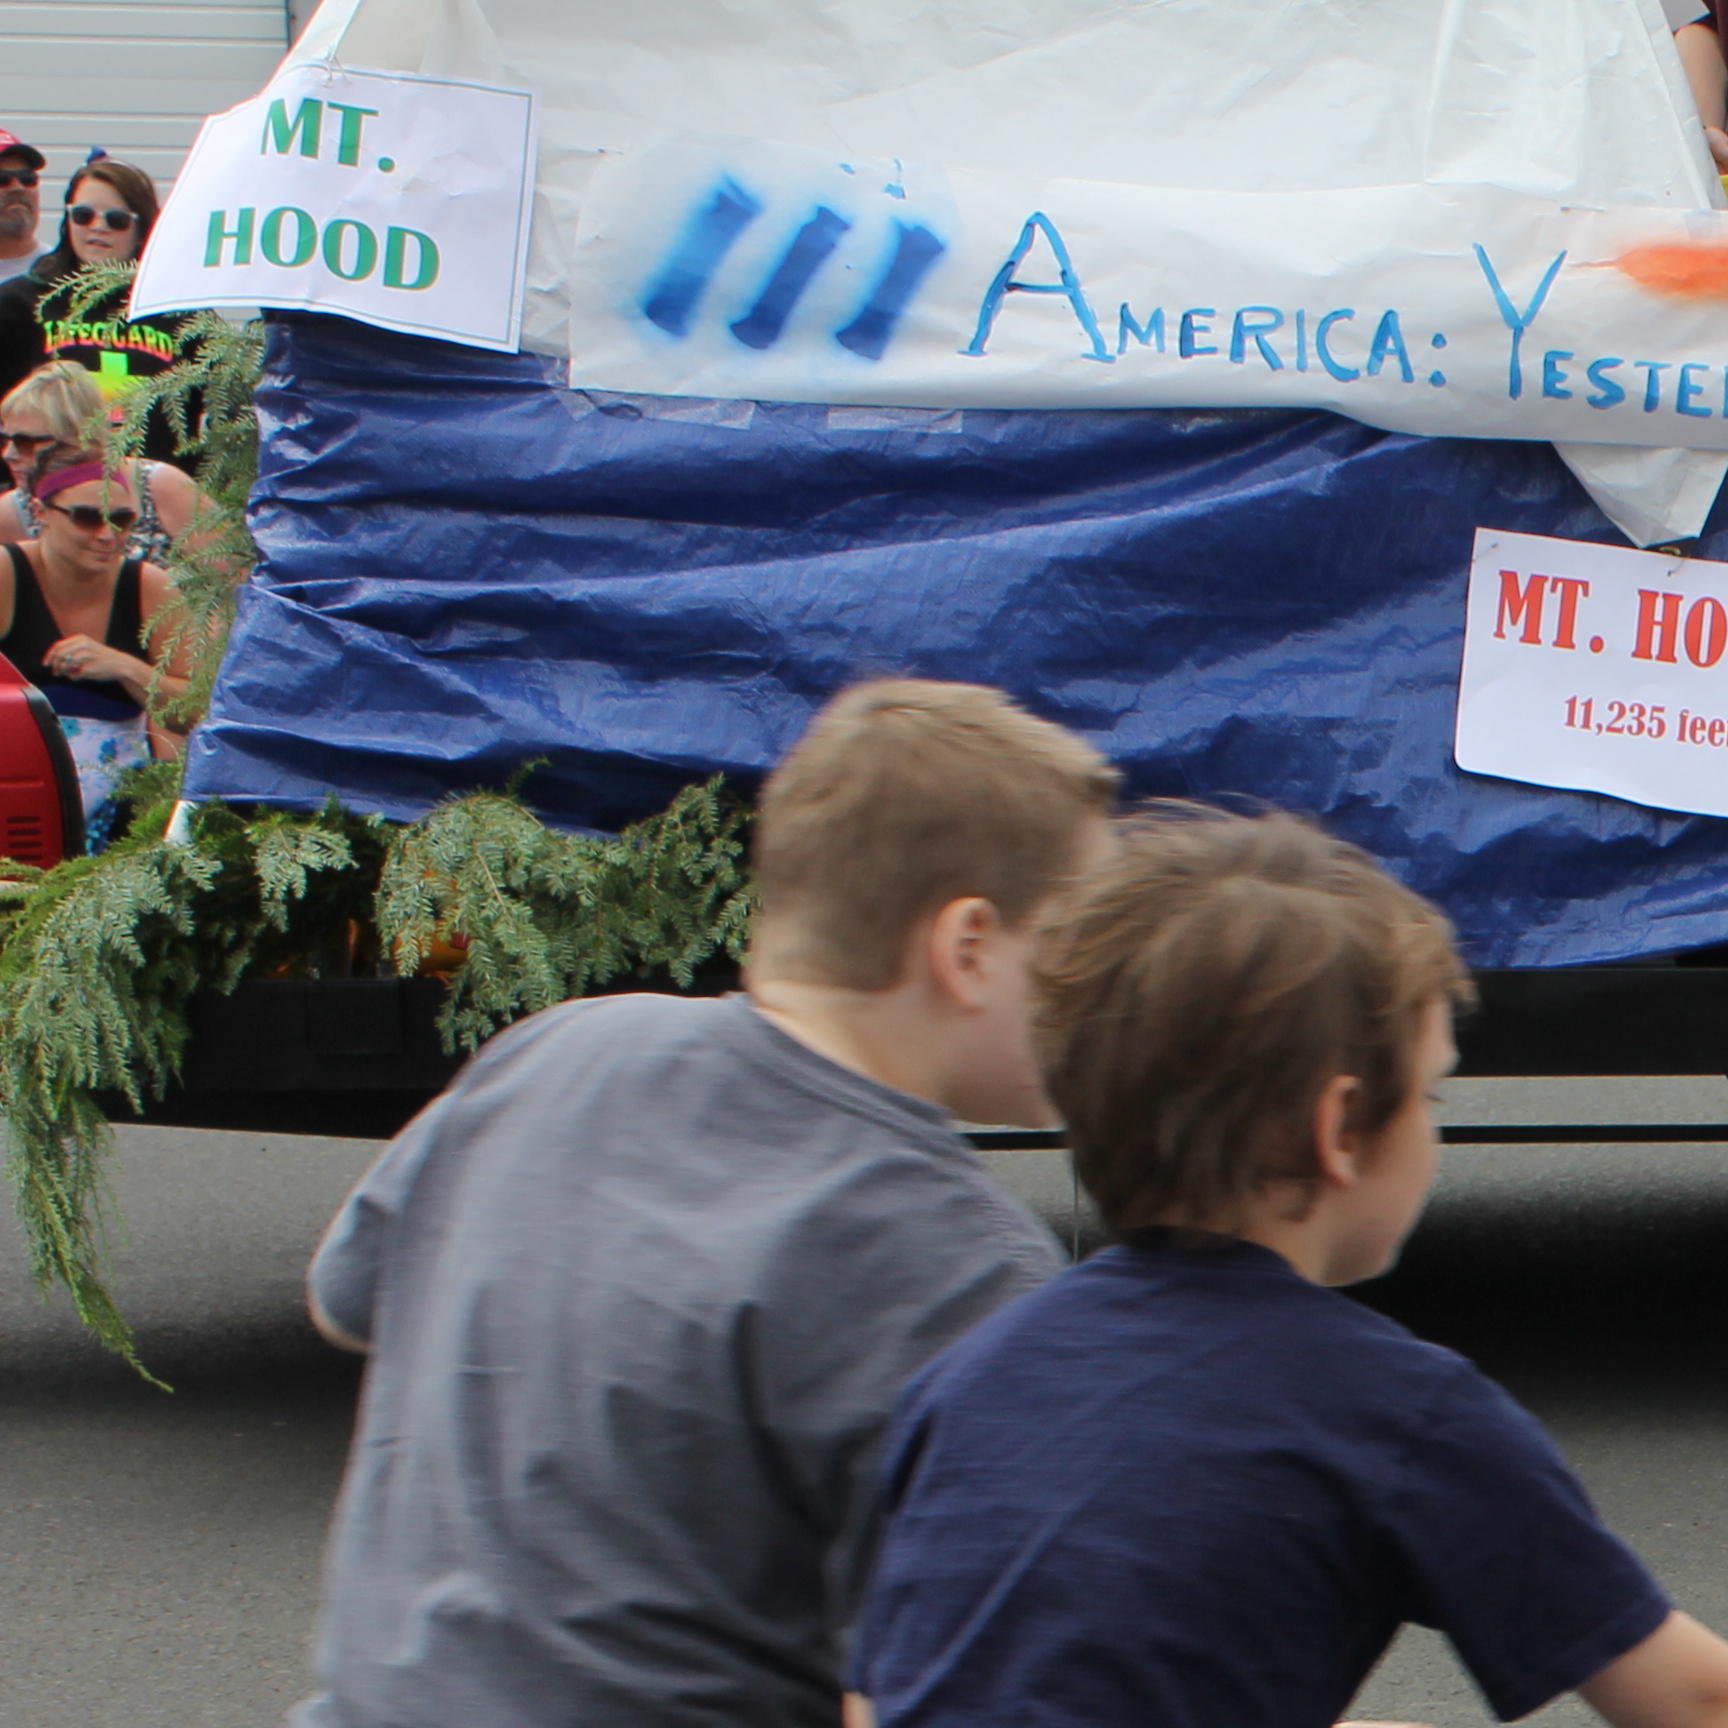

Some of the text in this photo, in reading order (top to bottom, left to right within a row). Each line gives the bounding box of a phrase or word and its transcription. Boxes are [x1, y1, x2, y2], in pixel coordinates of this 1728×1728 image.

[260, 97, 396, 174] MT.
[203, 205, 440, 290] HOOD
[957, 210, 1447, 387] AMERICA:
[1493, 570, 1605, 654] MT.
[1564, 695, 1666, 740] 11,235
